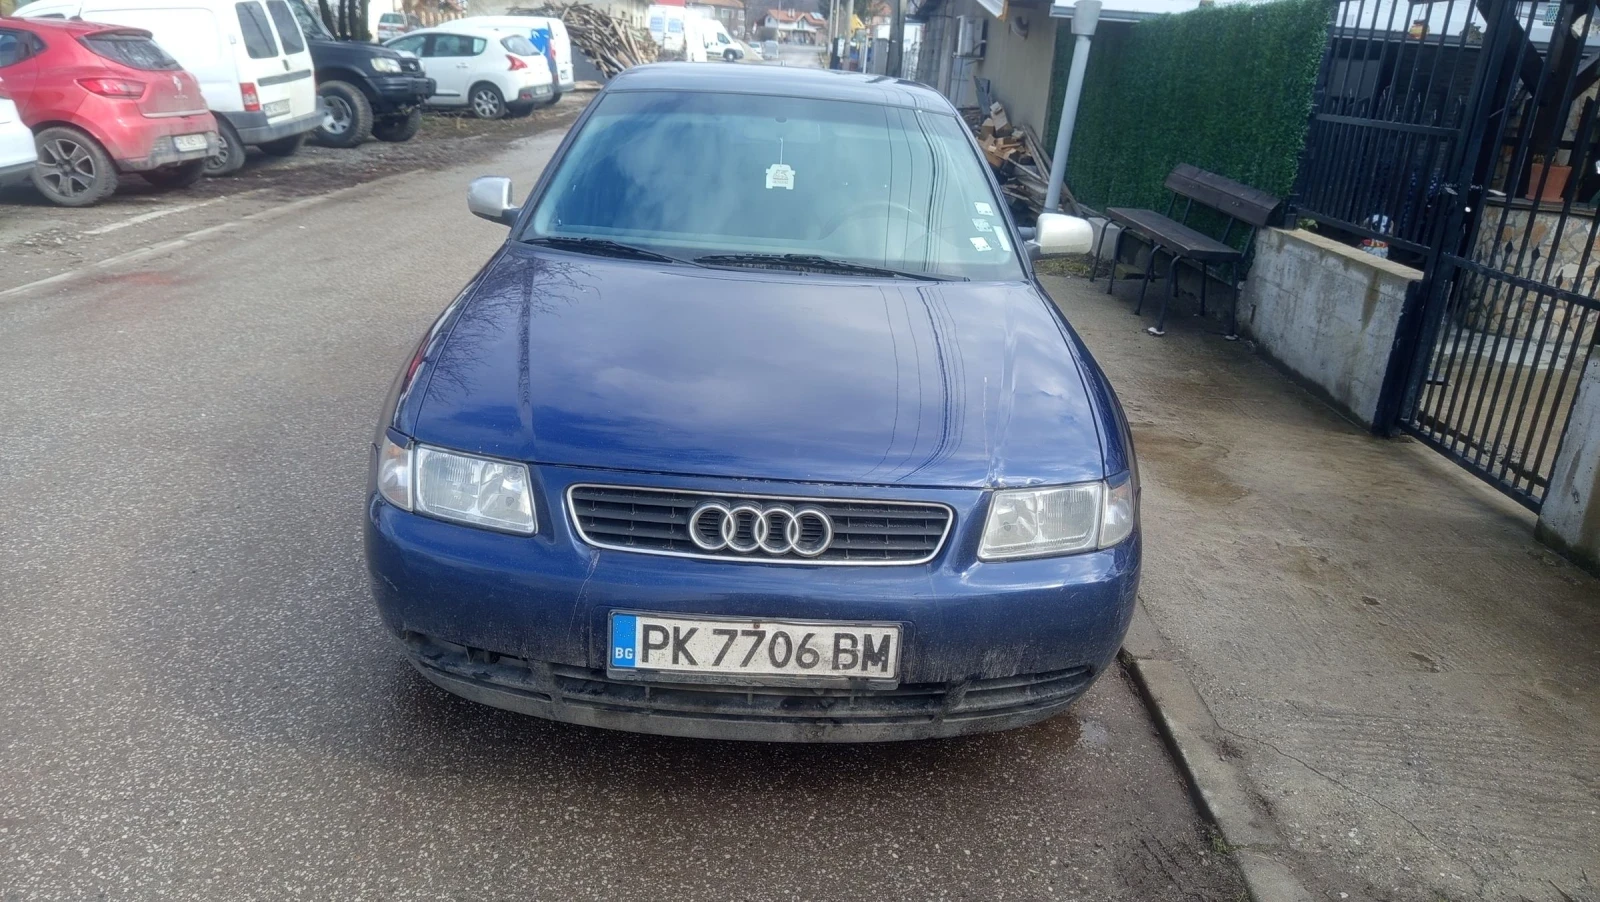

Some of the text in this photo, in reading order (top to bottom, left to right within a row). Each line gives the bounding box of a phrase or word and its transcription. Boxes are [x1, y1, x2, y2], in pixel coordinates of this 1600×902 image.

[615, 647, 633, 660] BG
[641, 624, 891, 672] PK 7706 BM
